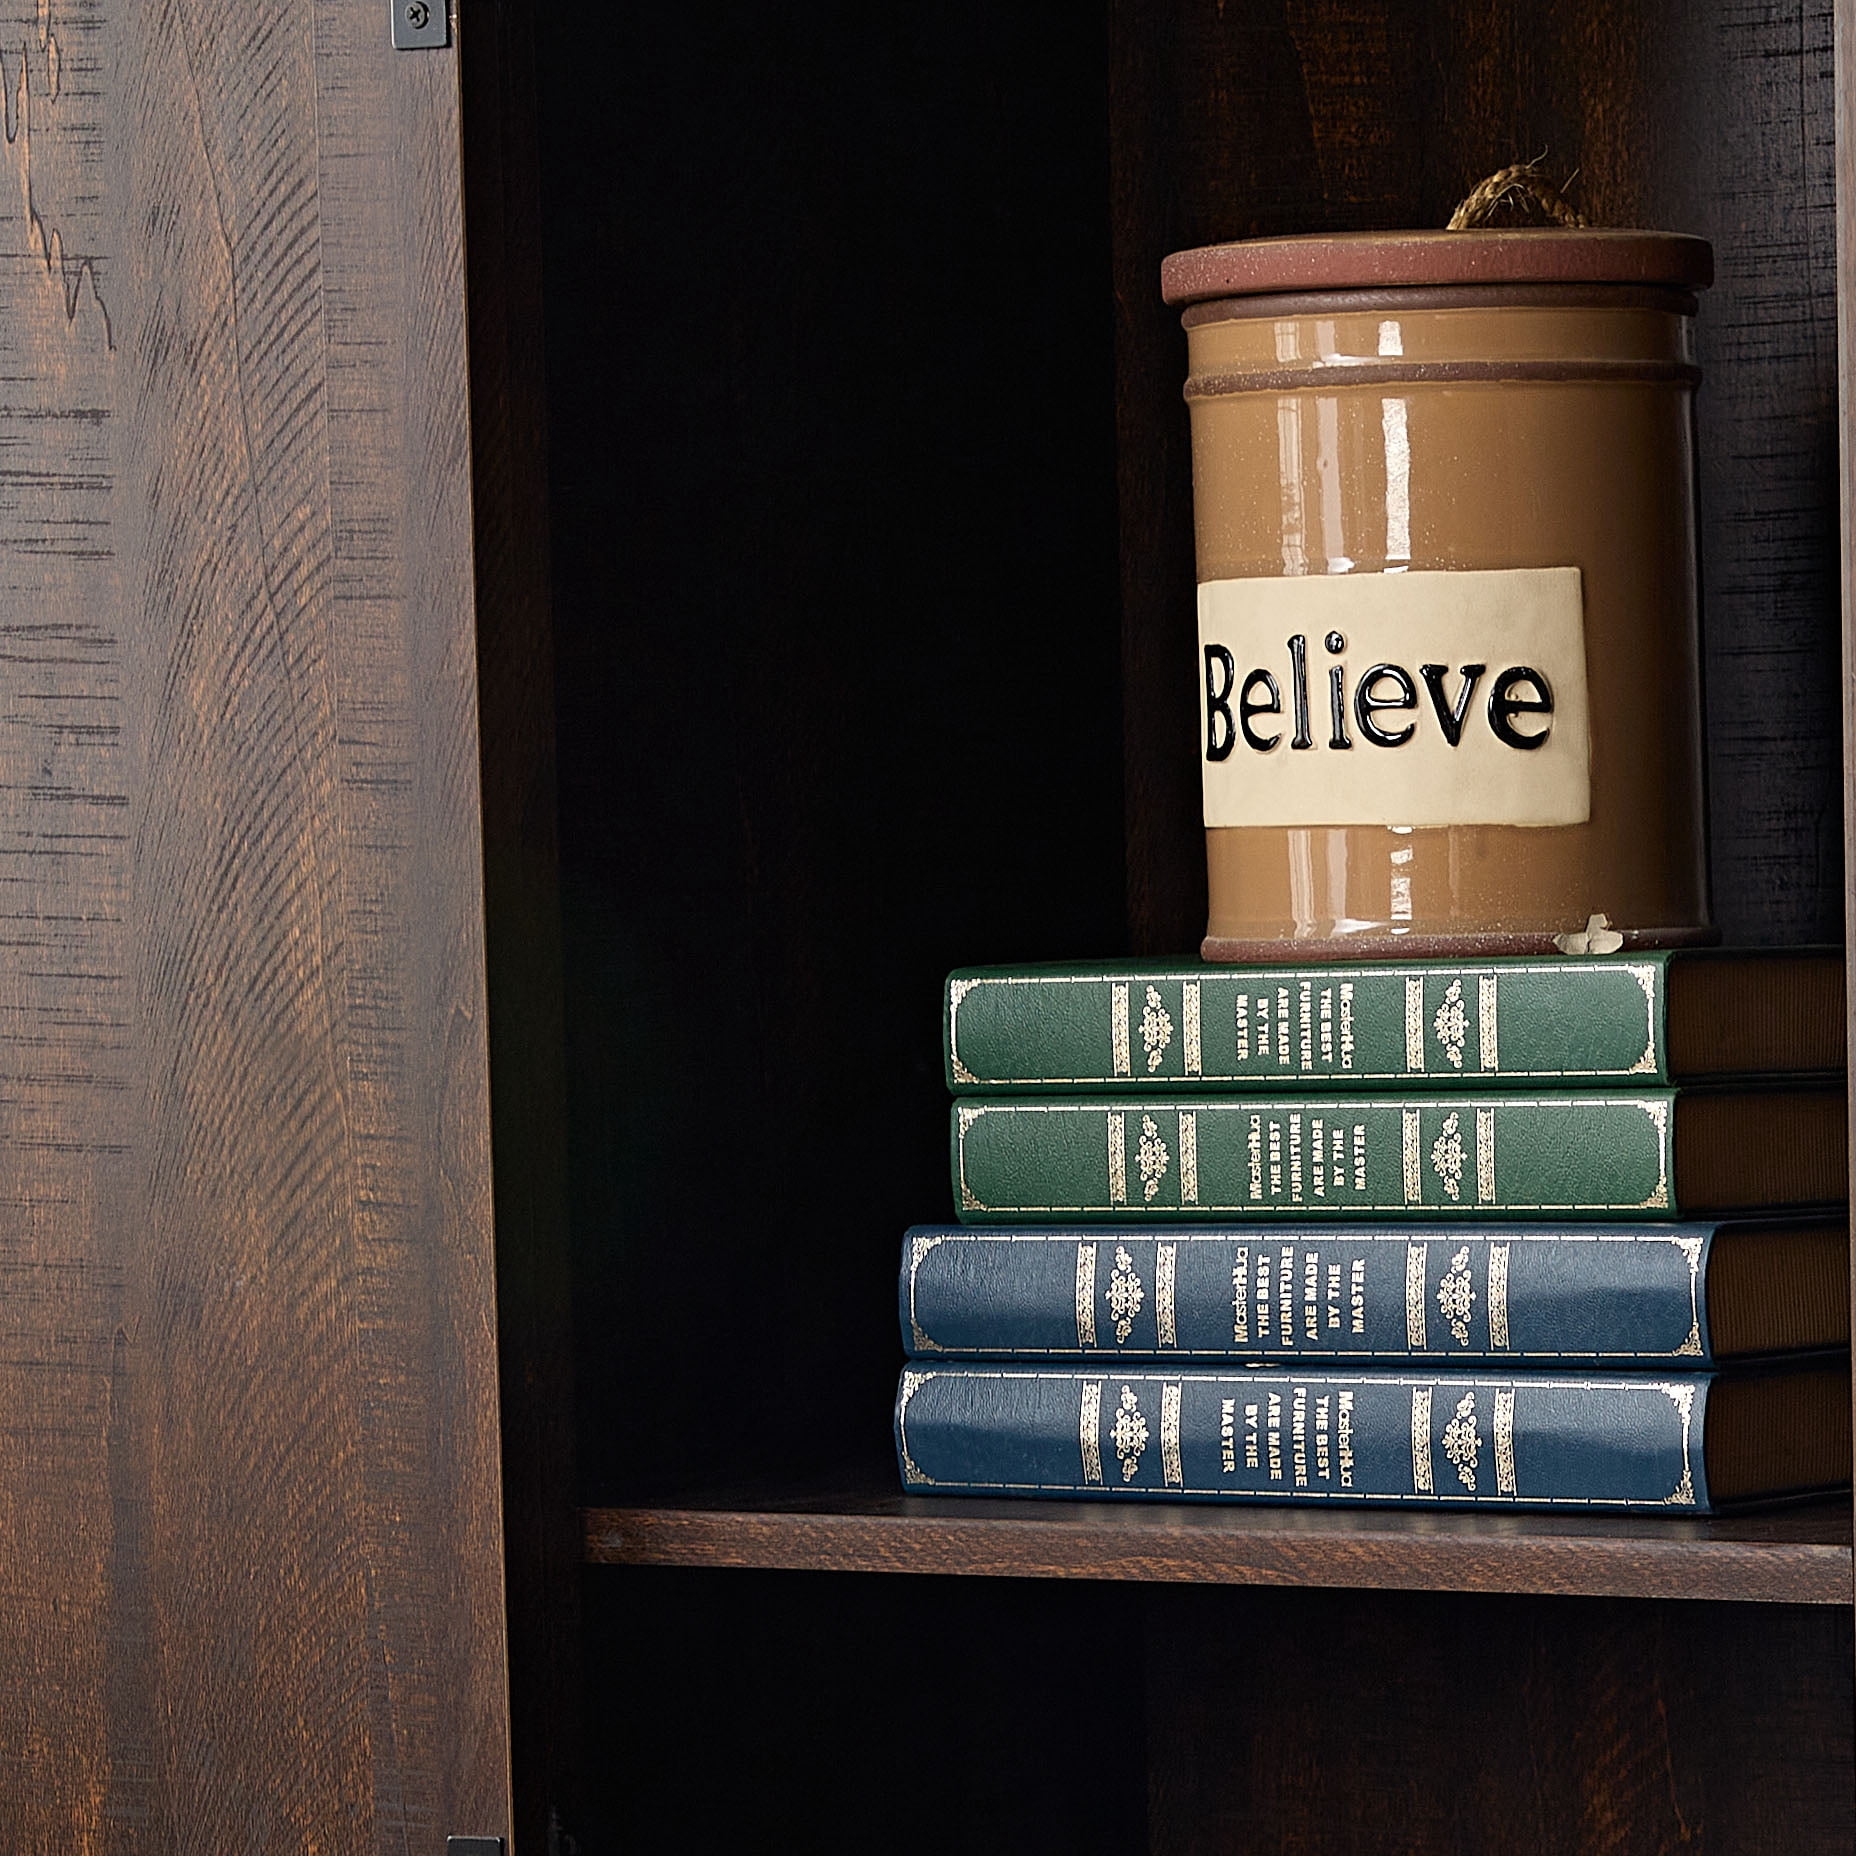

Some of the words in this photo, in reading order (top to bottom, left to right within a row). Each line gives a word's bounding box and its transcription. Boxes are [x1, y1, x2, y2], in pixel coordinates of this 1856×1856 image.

[1204, 630, 1554, 761] Believe
[1257, 998, 1269, 1019] BY
[1278, 987, 1289, 1018] ARE
[1320, 988, 1332, 1019] THE
[1236, 994, 1248, 1061] MASTER
[1258, 1023, 1269, 1055] THE
[1278, 1021, 1290, 1064] MADE
[1300, 981, 1312, 1070] FURNITURE
[1321, 1021, 1332, 1063] BEST
[1269, 1121, 1281, 1161] BEST
[1290, 1113, 1302, 1202] FURNITURE
[1312, 1119, 1324, 1163] MADE
[1332, 1129, 1344, 1161] THE
[1353, 1124, 1366, 1190] MASTER
[1270, 1164, 1281, 1195] THE
[1313, 1165, 1325, 1197] ARE
[1333, 1166, 1344, 1186] BY
[1257, 1254, 1271, 1300] BEST
[1280, 1246, 1293, 1346] FURNITURE
[1305, 1252, 1318, 1301] MADE
[1328, 1264, 1341, 1300] THE
[1351, 1259, 1365, 1333] MASTER
[1257, 1304, 1270, 1338] THE
[1305, 1305, 1318, 1340] ARE
[1328, 1305, 1340, 1328] BY
[1245, 1404, 1258, 1428] BY
[1268, 1392, 1281, 1428] ARE
[1315, 1395, 1330, 1431] THE
[1221, 1399, 1235, 1473] MASTER
[1245, 1432, 1258, 1468] THE
[1268, 1432, 1282, 1480] MADE
[1292, 1387, 1307, 1487] FURNITURE
[1316, 1434, 1330, 1480] BEST
